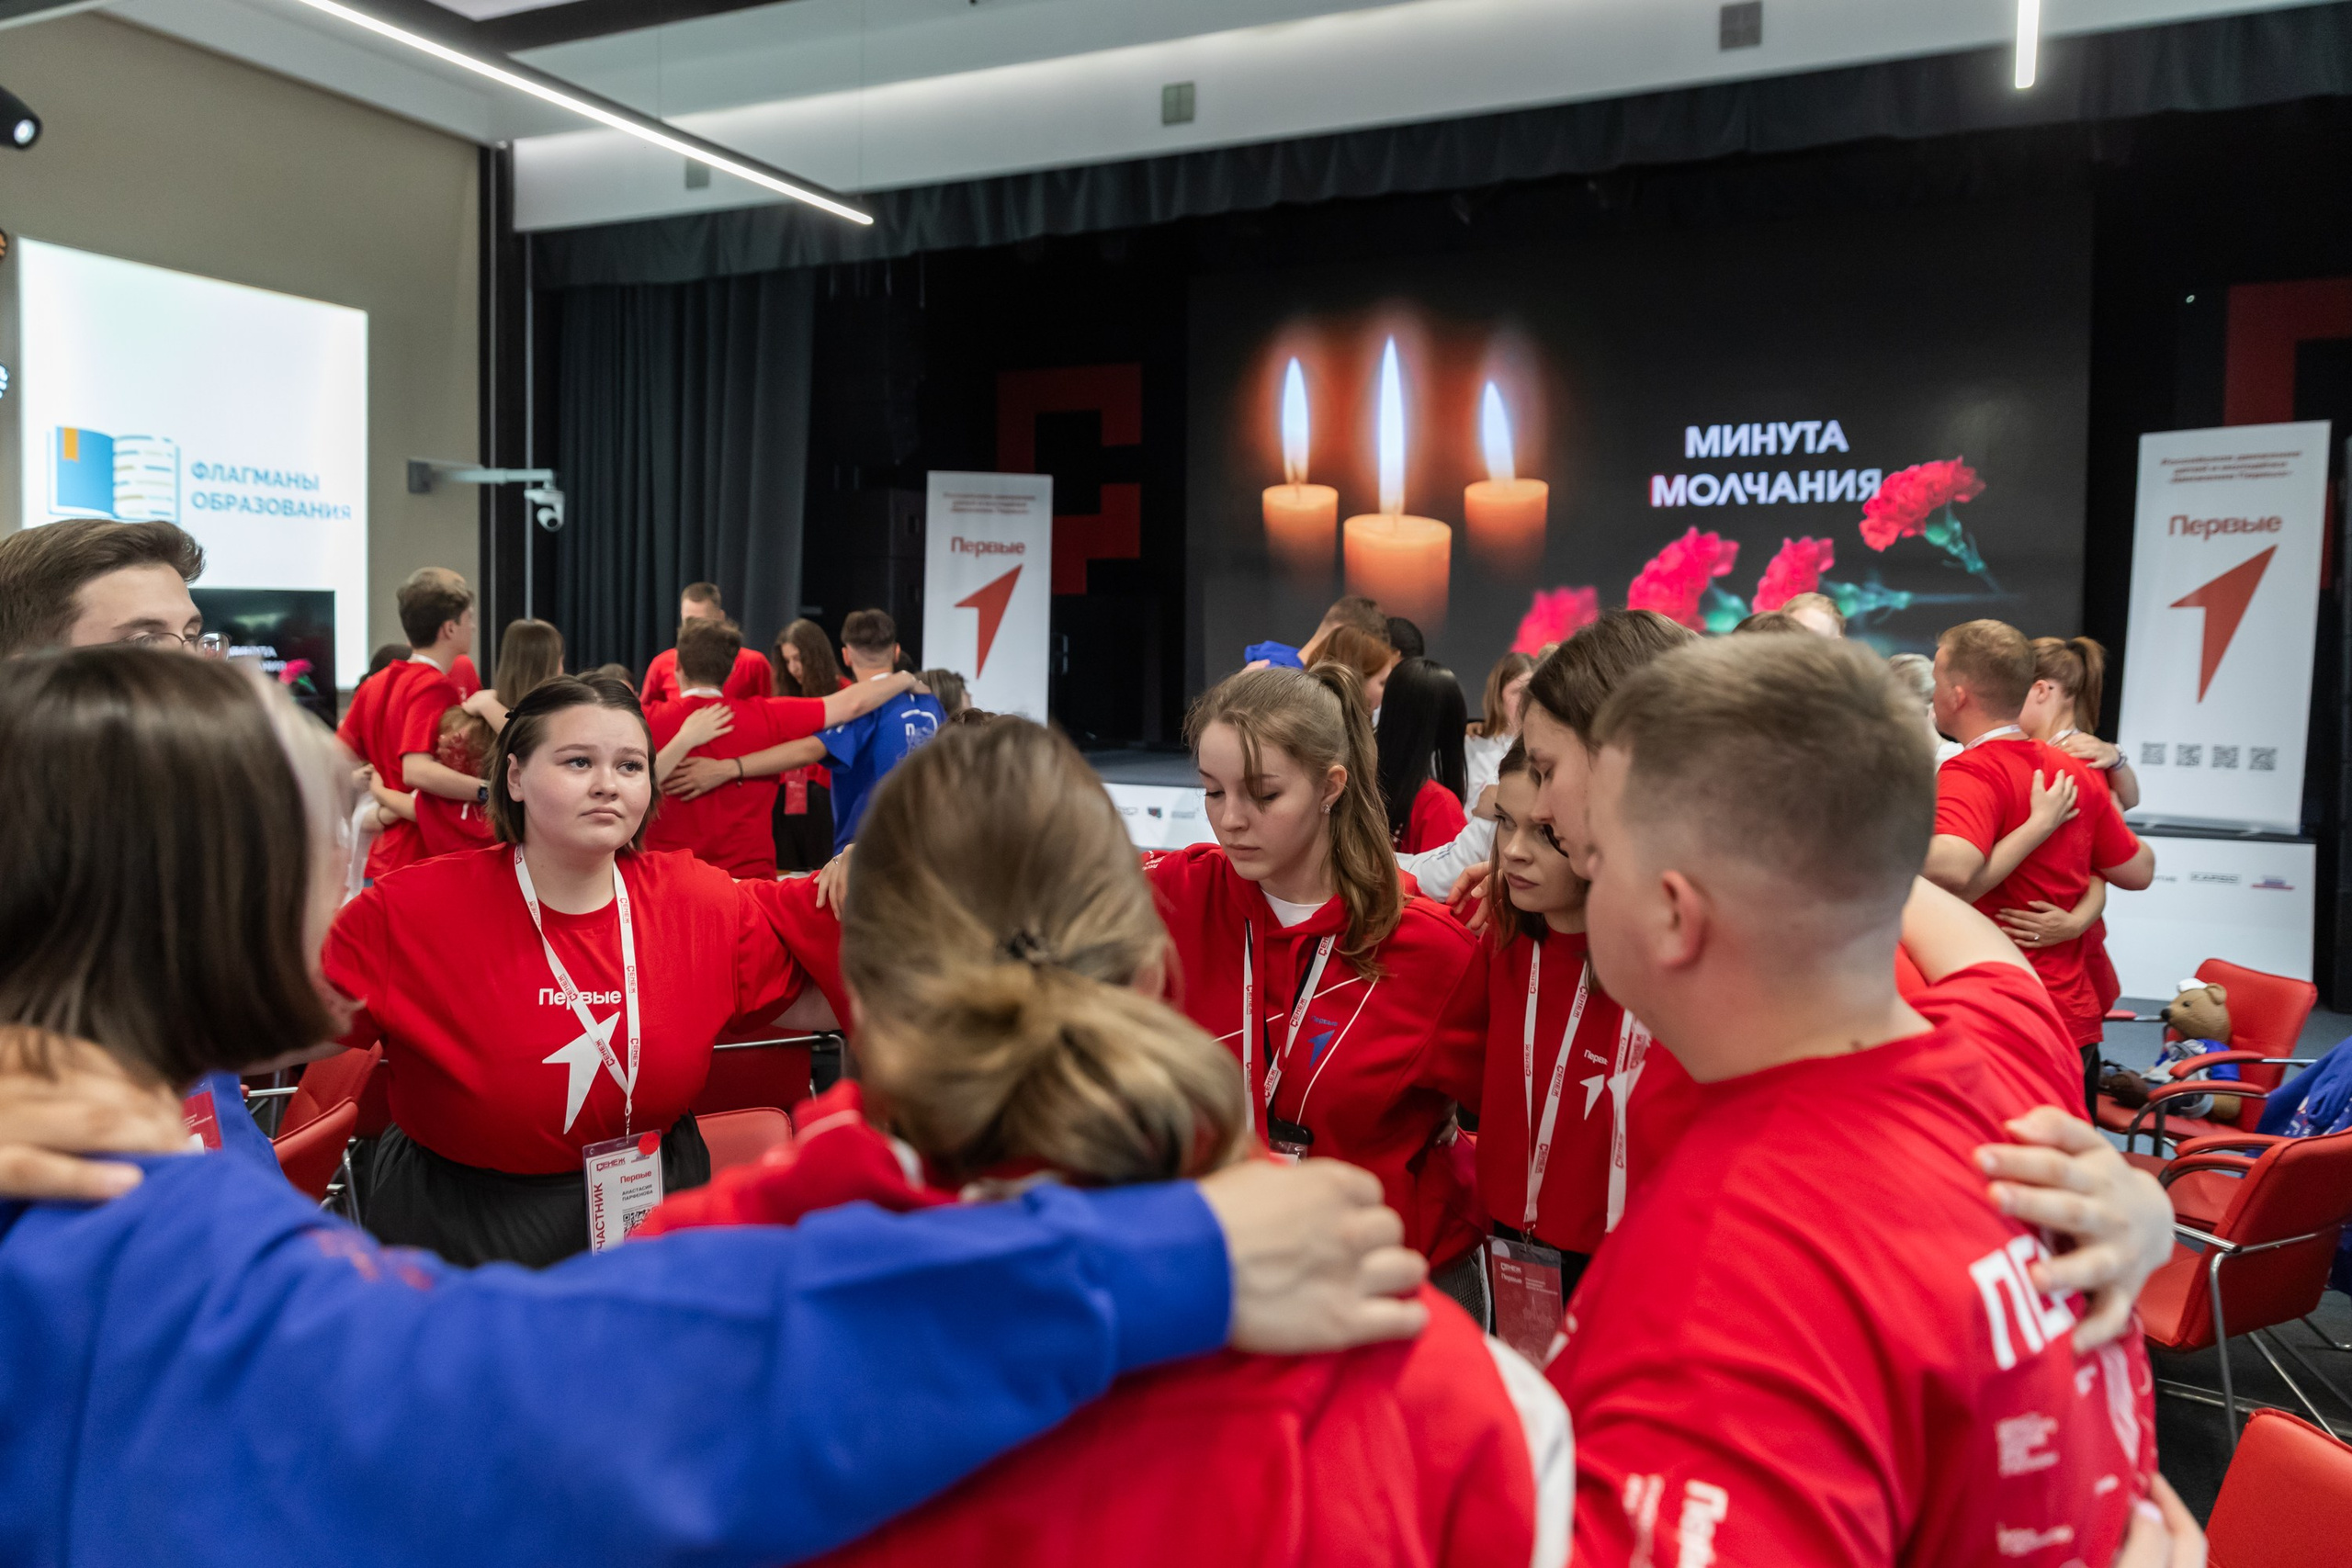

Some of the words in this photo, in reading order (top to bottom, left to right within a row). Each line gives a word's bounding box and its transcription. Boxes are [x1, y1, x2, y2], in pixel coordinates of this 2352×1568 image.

[1685, 420, 1849, 458] МИНУТА
[191, 460, 320, 491] ФЛАГМАНЫ
[1651, 468, 1883, 507] МОЛЧАНИЯ
[191, 491, 352, 520] ОБРАЗОВАНИЯ
[2169, 514, 2283, 541] Первые
[950, 536, 1026, 558] Первые
[620, 1170, 652, 1183] Первые
[594, 1182, 605, 1251] ЧАСТНИК
